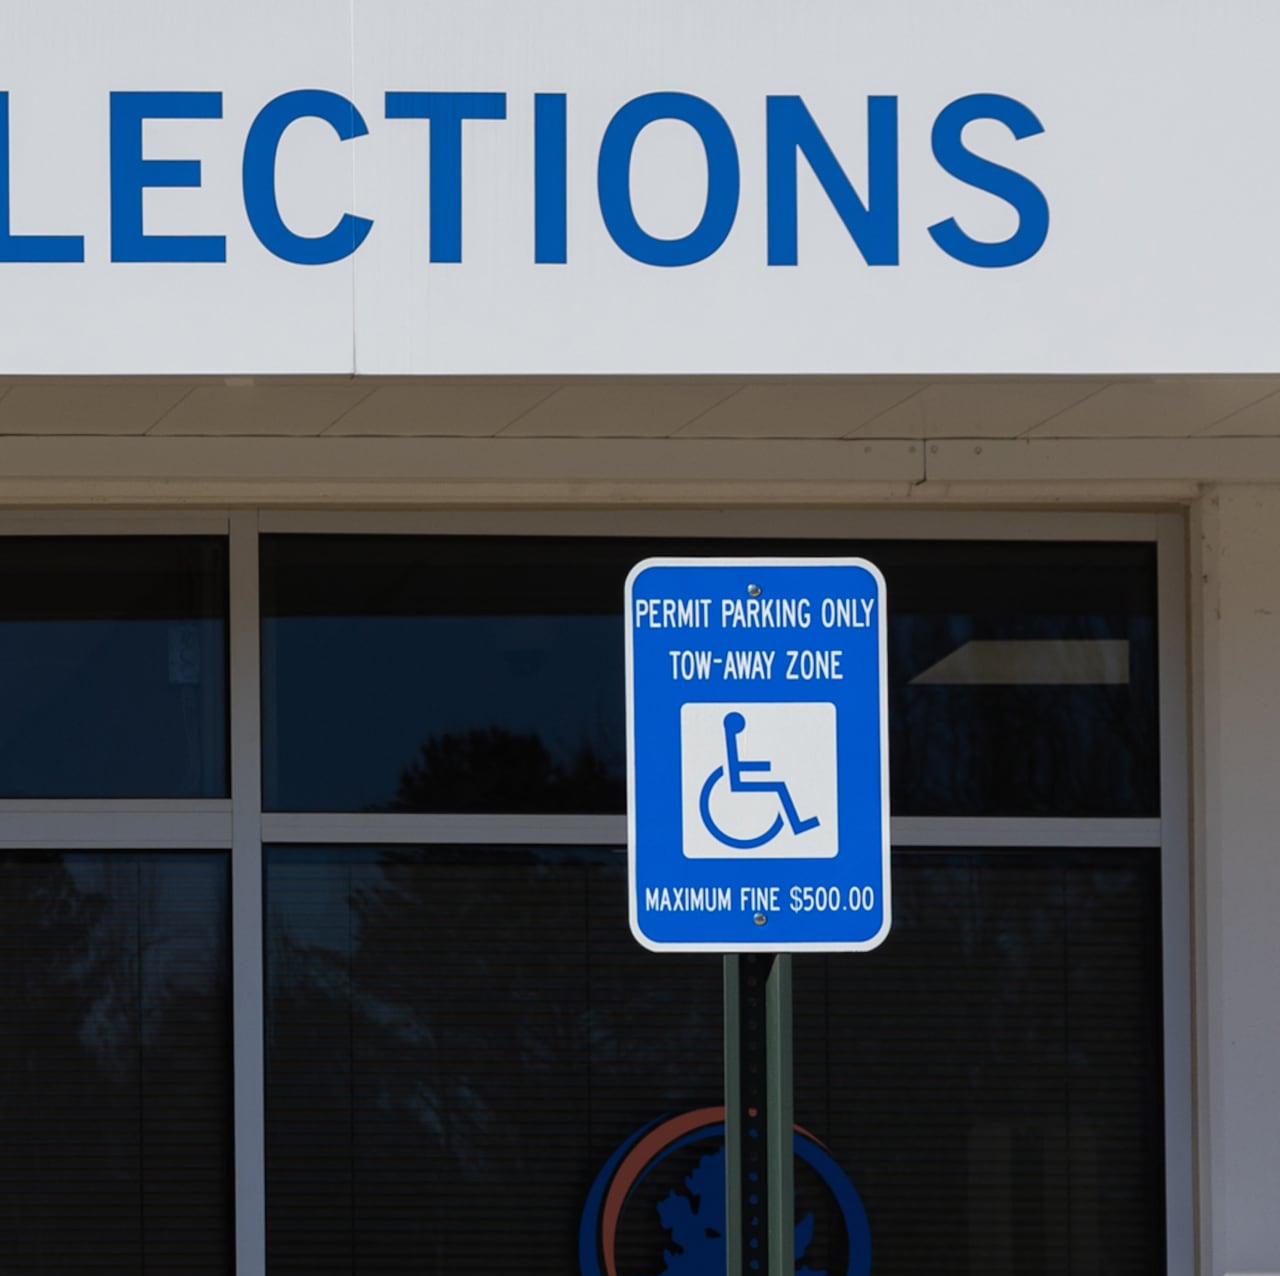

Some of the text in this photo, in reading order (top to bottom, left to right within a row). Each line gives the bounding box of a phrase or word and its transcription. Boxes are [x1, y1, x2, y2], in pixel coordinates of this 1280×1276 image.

[636, 598, 874, 628] PERMIT PARKING ONLY
[669, 651, 843, 680] TOW-AWAY ZONE
[645, 886, 874, 912] MAXIMUM FINE $500.00
